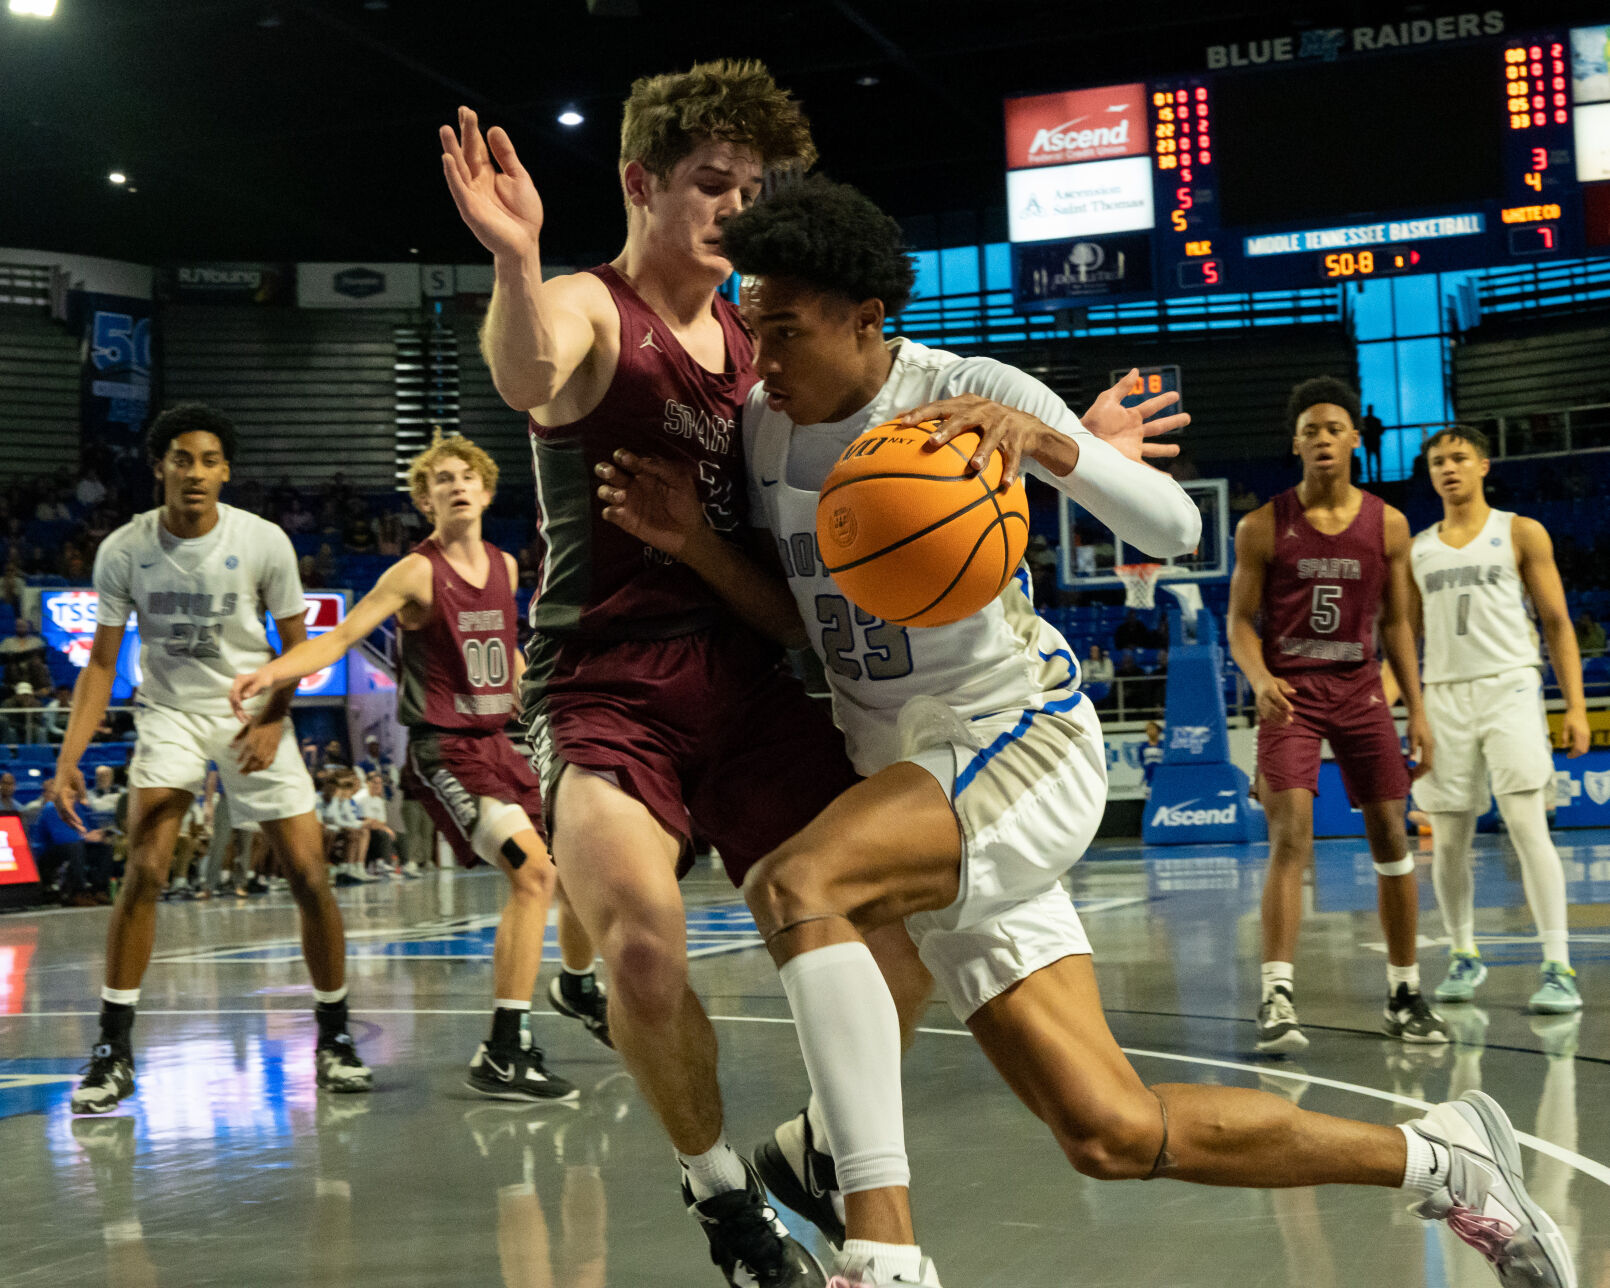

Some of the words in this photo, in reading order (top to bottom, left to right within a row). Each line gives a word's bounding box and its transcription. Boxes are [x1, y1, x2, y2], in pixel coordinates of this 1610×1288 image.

[1207, 37, 1294, 69] BLUE
[1353, 11, 1505, 50] RAIDERS
[1551, 43, 1563, 58] 2
[1028, 118, 1130, 155] Ascend
[1197, 119, 1209, 133] 2
[1531, 148, 1548, 170] 3
[1180, 168, 1193, 182] 5
[1524, 172, 1542, 192] 4
[1176, 187, 1193, 209] 5
[1171, 209, 1187, 231] 5
[1248, 234, 1300, 256] MIDDLE
[1305, 225, 1386, 249] TENNESSEE
[1389, 215, 1480, 242] BASKETBALL
[1537, 227, 1552, 248] 7
[431, 271, 444, 290] S
[1202, 262, 1218, 284] 5
[887, 437, 915, 446] NXT
[1297, 558, 1361, 579] SPARTA
[1309, 585, 1342, 634] 5
[1456, 594, 1470, 636] 1
[815, 594, 914, 681] 23
[462, 637, 509, 687] 00
[1152, 803, 1238, 828] Ascend
